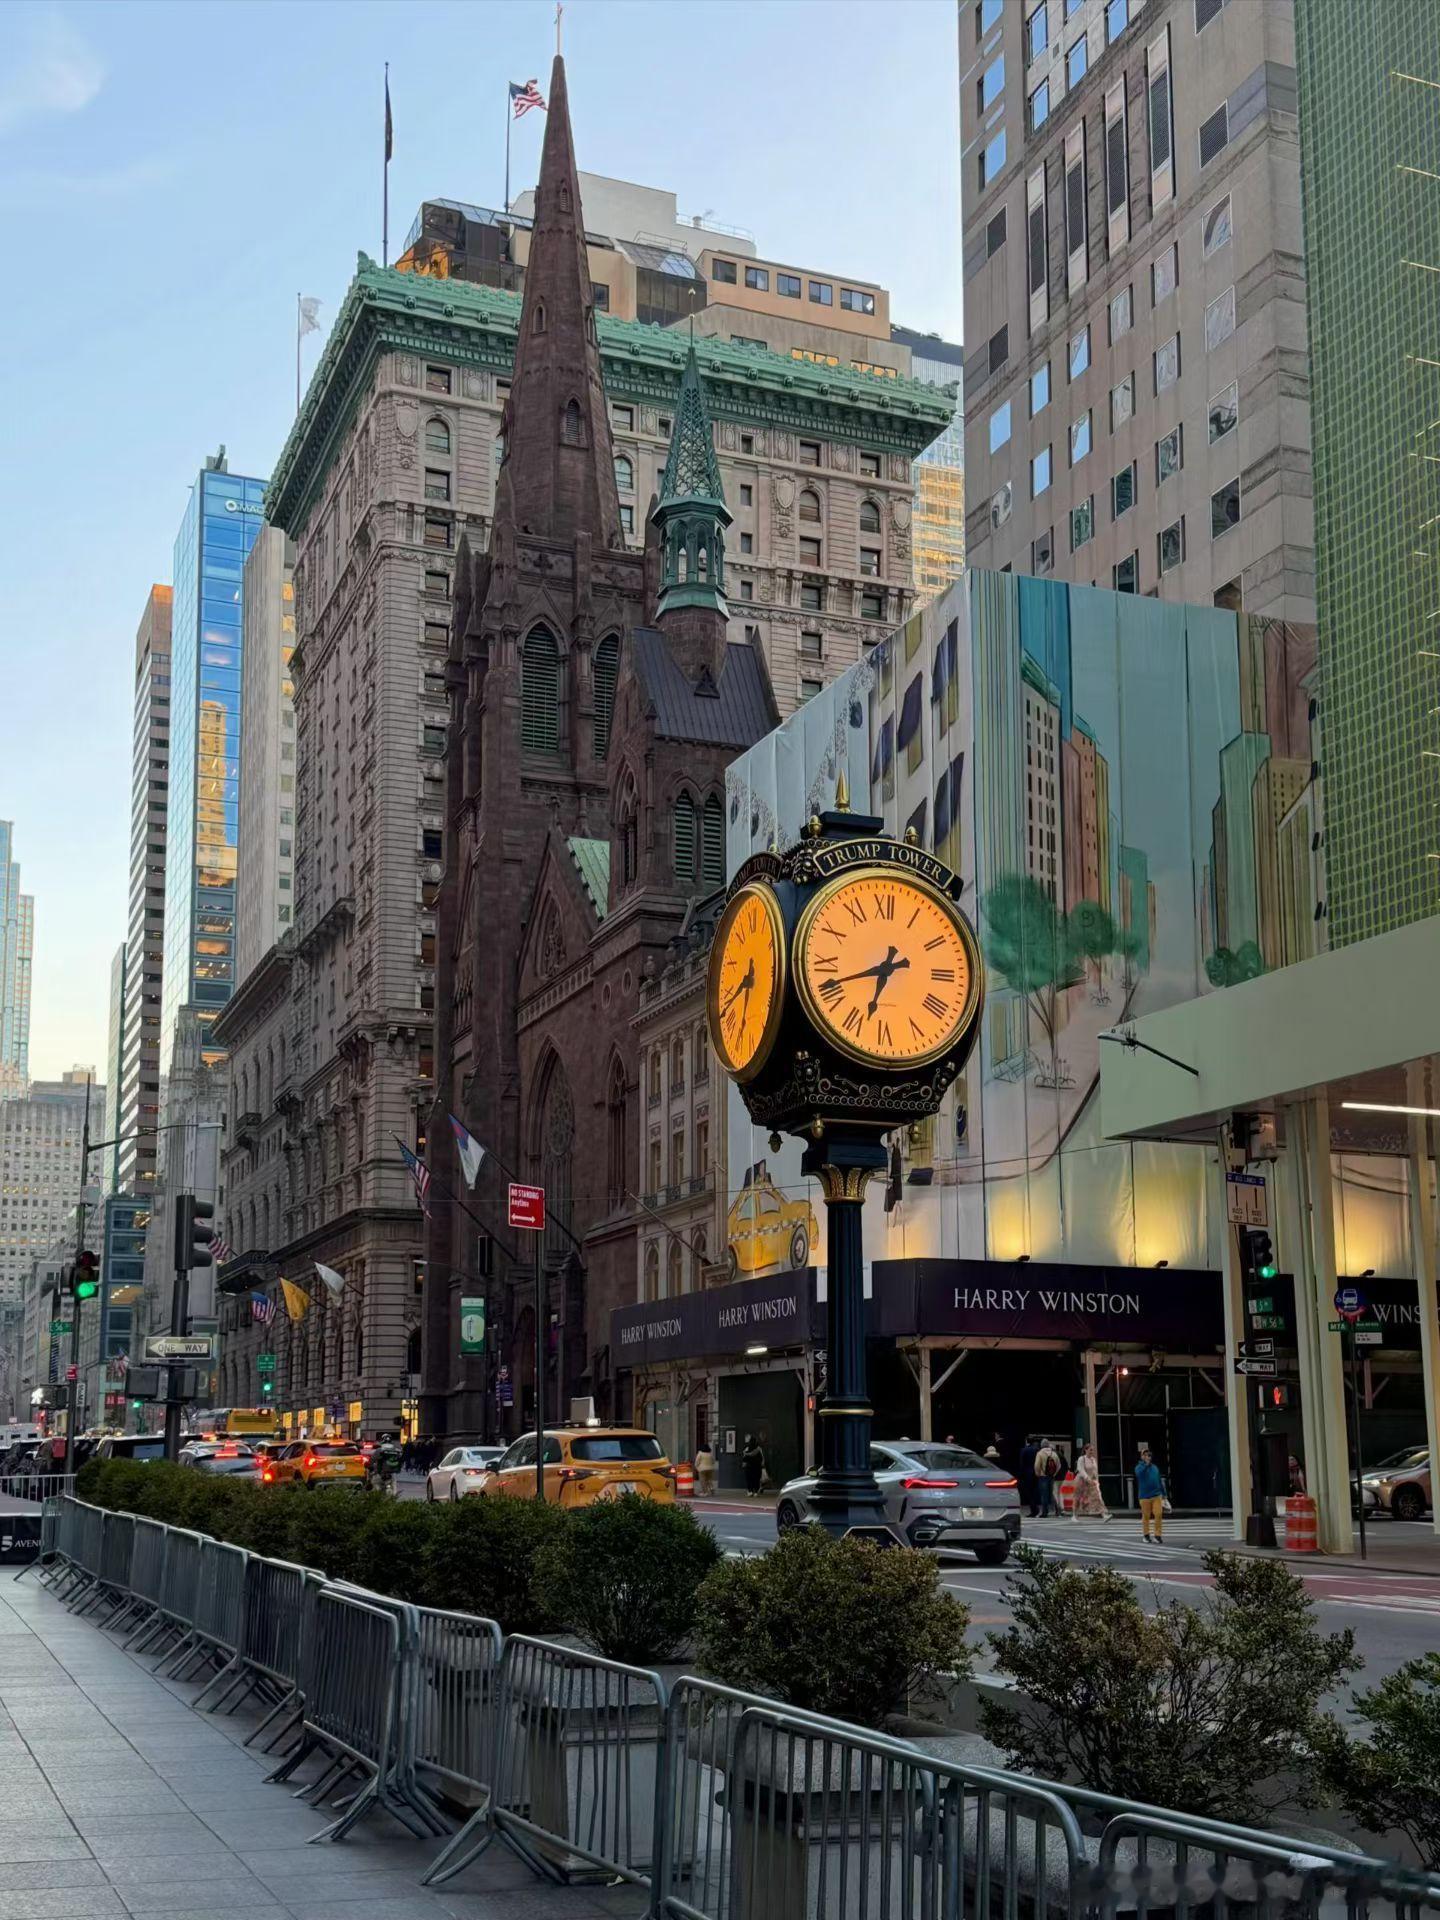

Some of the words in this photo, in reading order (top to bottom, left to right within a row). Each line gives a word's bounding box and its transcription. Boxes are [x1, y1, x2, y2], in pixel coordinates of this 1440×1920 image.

[823, 843, 880, 868] TRUMP
[888, 845, 942, 880] TOWER
[843, 897, 867, 927] XI
[874, 893, 895, 920] XII
[821, 920, 847, 945] X
[923, 935, 947, 951] II
[814, 953, 839, 973] IX
[931, 968, 955, 982] III
[878, 1019, 893, 1047] VI
[909, 1016, 925, 1041] V
[511, 1188, 518, 1197] NO
[718, 1305, 750, 1329] HARRY
[751, 1296, 797, 1321] WINSTON
[954, 1288, 1031, 1311] HARRY
[1038, 1290, 1140, 1315] WINSTON
[1372, 1303, 1422, 1325] WINS
[621, 1324, 646, 1345] HARRY
[646, 1316, 682, 1340] WINSTON
[158, 1344, 176, 1353] ONE
[184, 1344, 204, 1353] WAY
[1259, 1363, 1273, 1372] WAY
[1, 1535, 13, 1552] 5
[14, 1539, 45, 1548] AVENU
